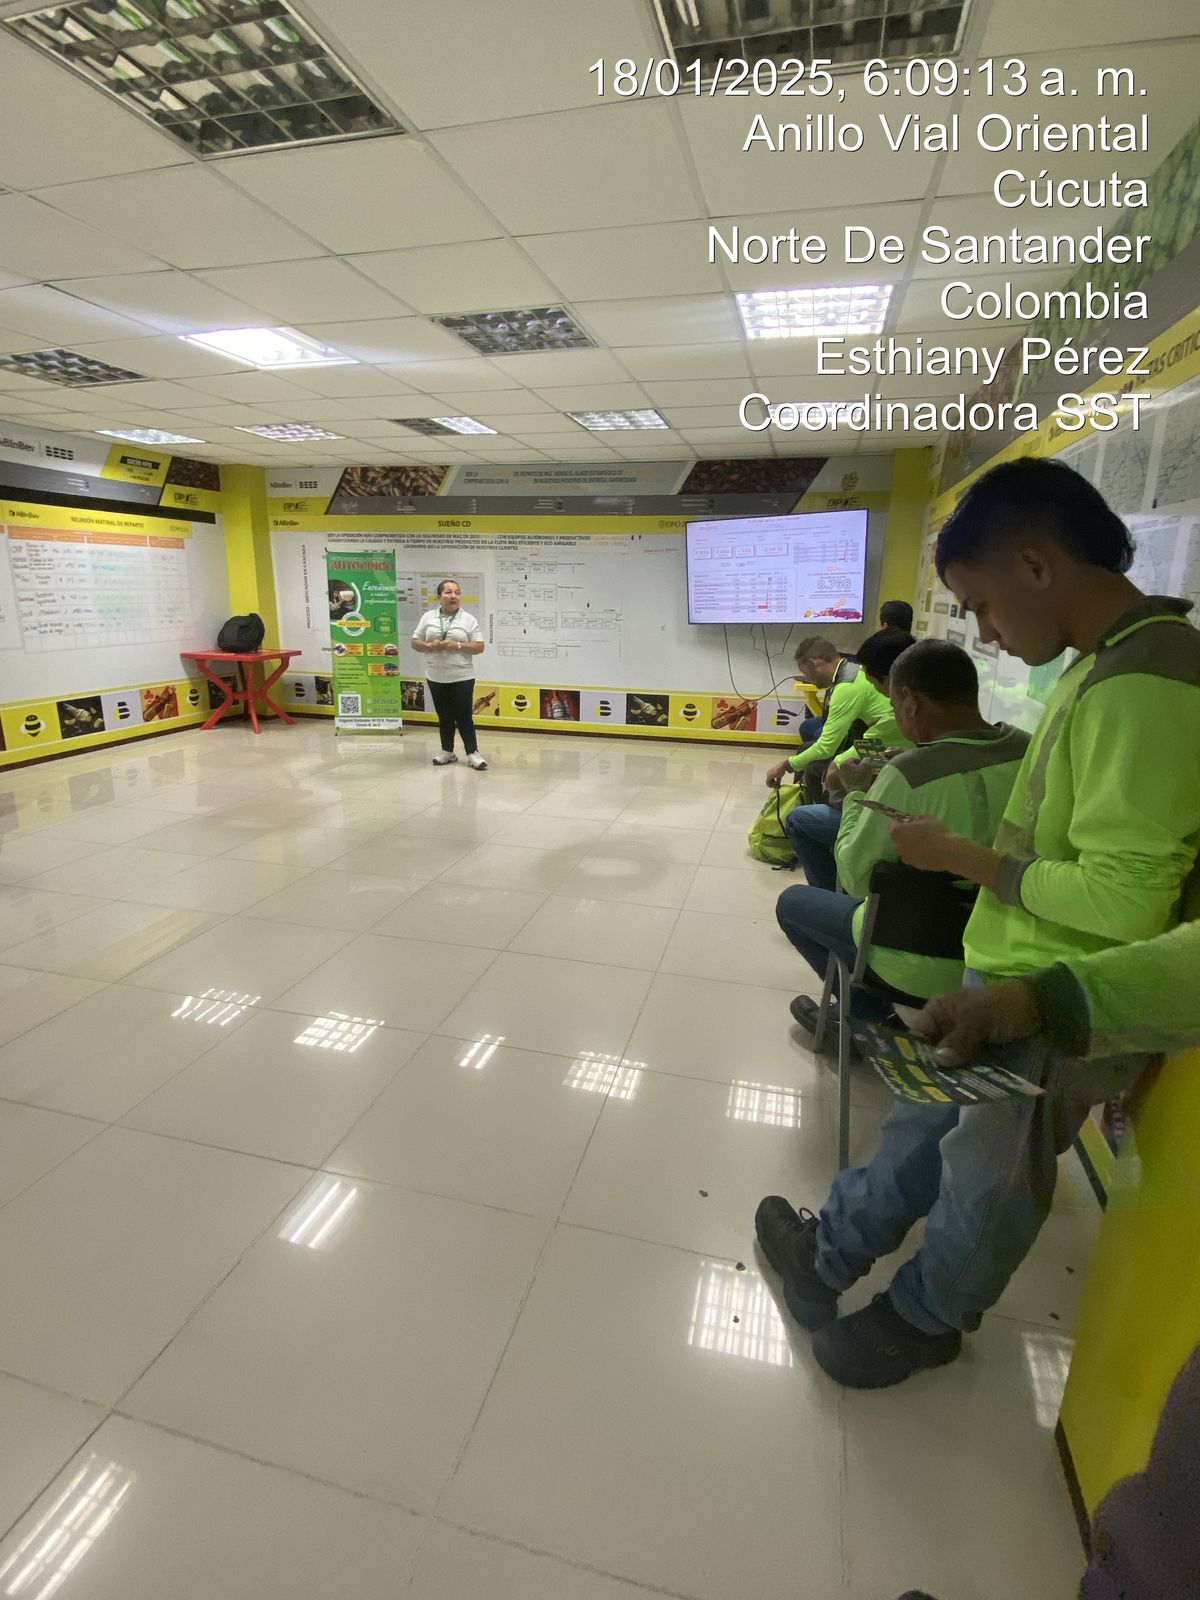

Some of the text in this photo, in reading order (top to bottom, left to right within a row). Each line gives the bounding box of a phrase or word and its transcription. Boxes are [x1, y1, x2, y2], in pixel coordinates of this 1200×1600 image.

[71, 515, 95, 524] REUNIÓN
[124, 520, 144, 528] REPARTO
[438, 519, 471, 528] SUEÑO CD
[331, 560, 394, 571] AUTOCINCO
